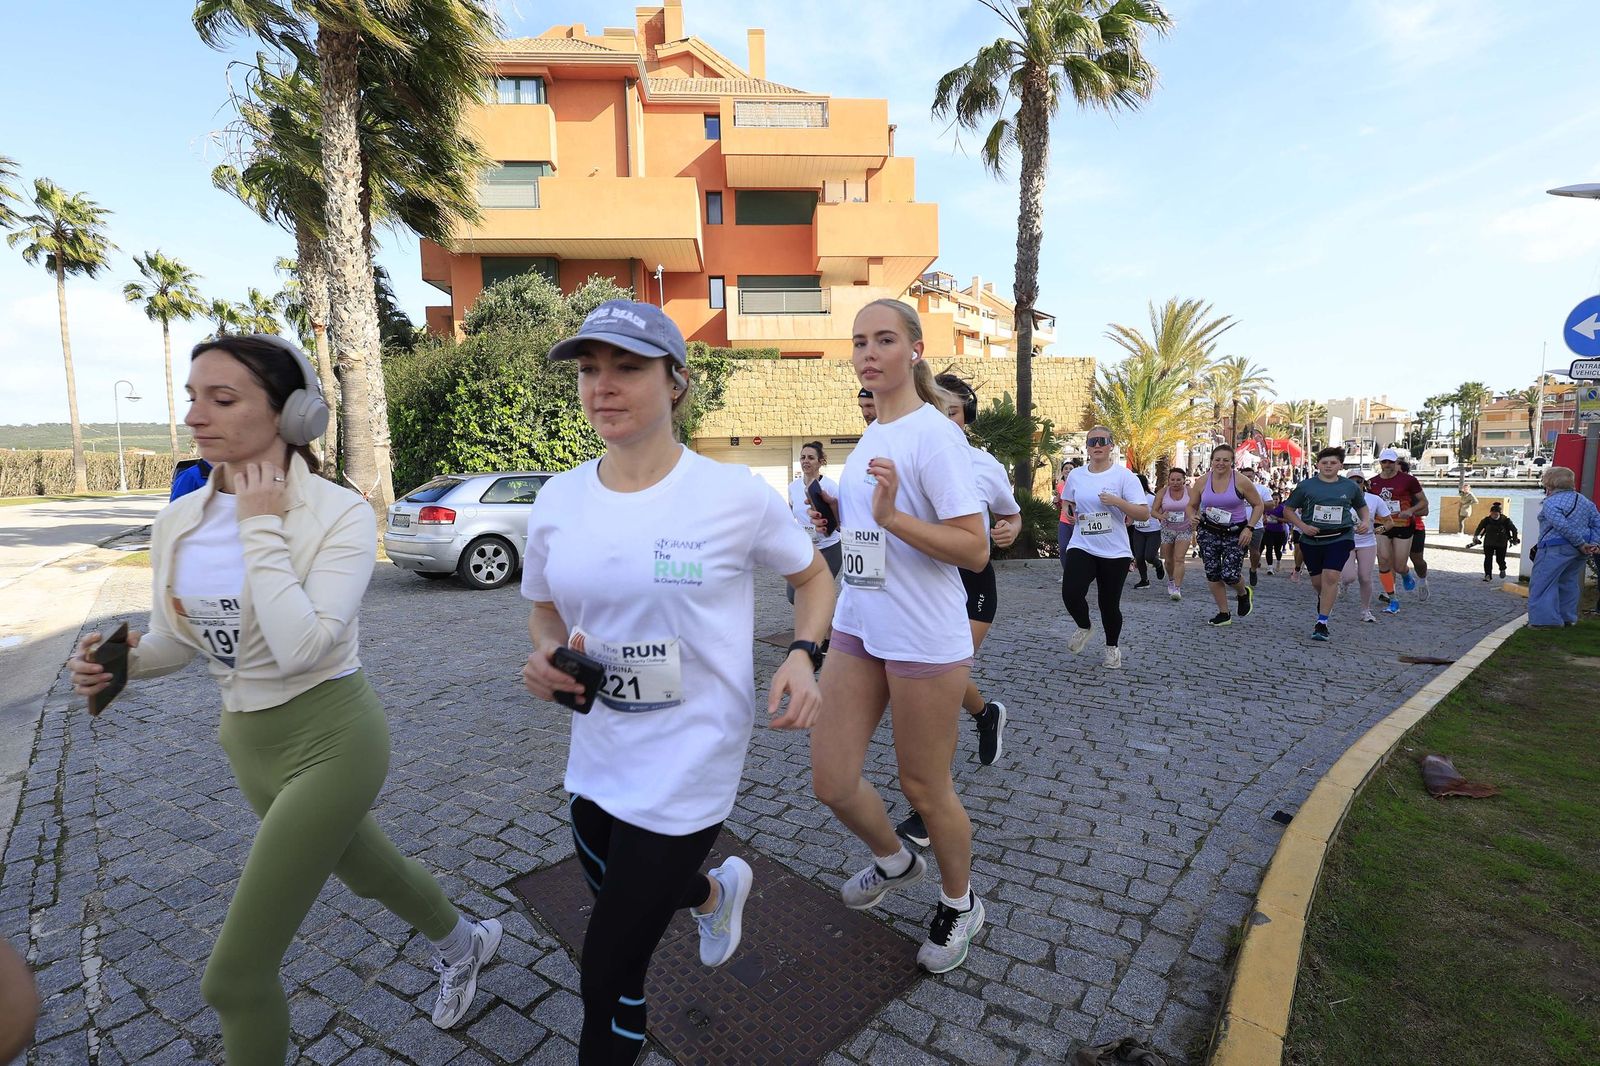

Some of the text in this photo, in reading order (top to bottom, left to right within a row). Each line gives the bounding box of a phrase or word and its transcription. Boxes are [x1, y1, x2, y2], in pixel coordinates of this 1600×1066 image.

[1087, 522, 1102, 531] 140
[855, 531, 880, 542] RUN
[654, 550, 671, 560] The
[655, 560, 703, 579] RUN
[621, 643, 667, 660] RUN
